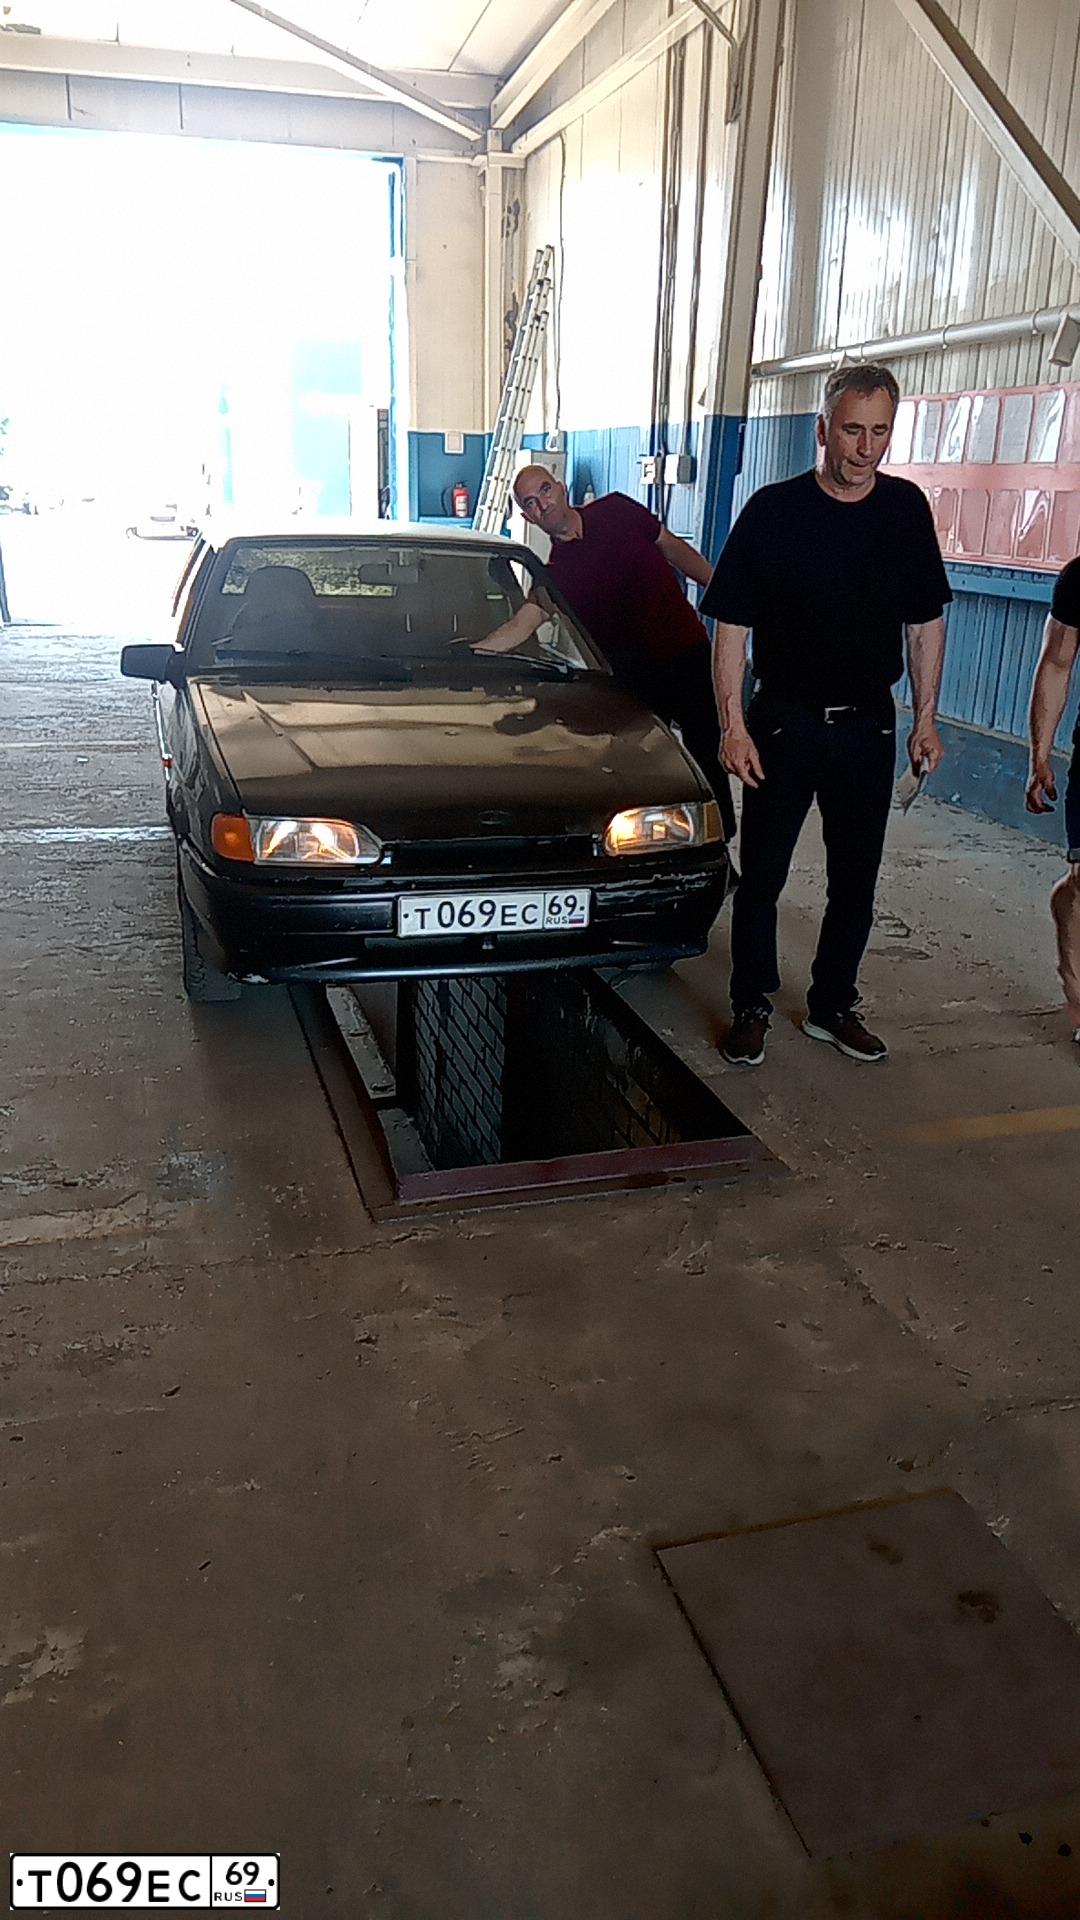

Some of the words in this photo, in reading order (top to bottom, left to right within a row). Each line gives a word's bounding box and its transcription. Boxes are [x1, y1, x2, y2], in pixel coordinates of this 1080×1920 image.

[414, 899, 539, 930] T069EC
[548, 894, 578, 916] 69
[545, 916, 568, 925] RUS
